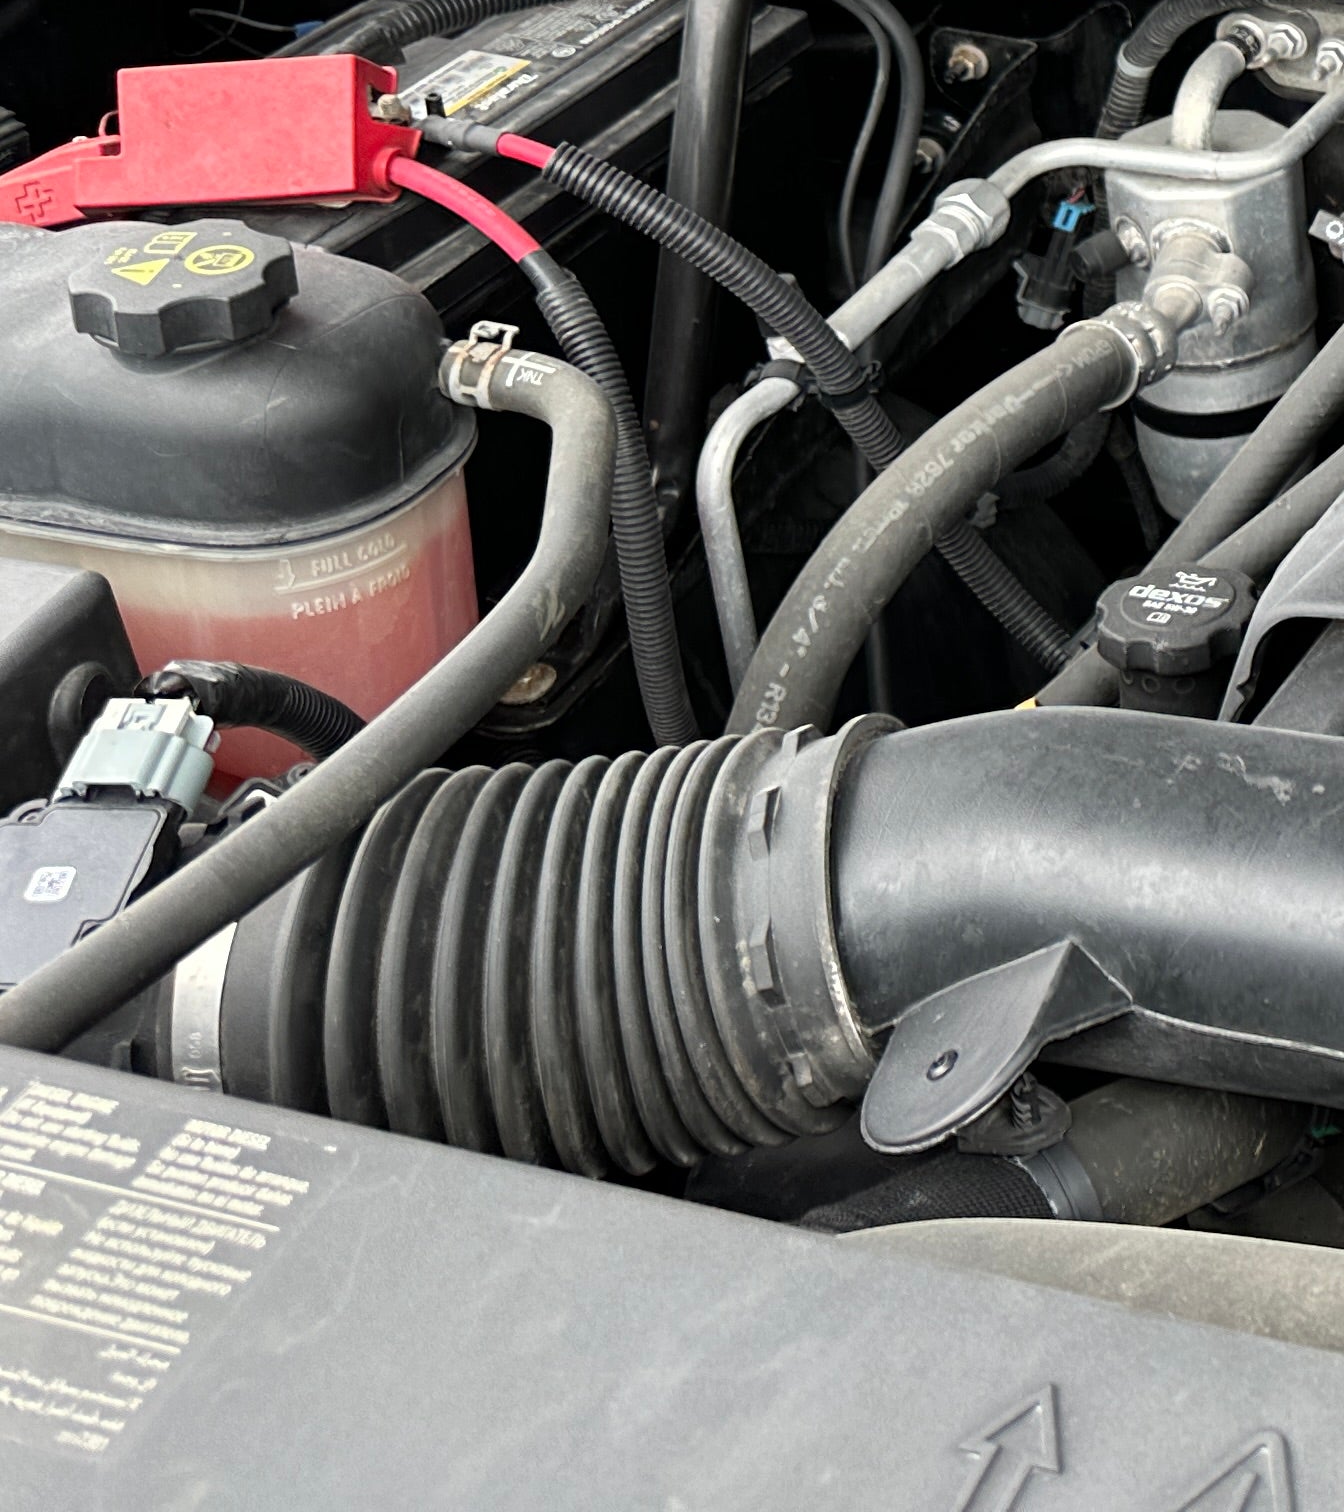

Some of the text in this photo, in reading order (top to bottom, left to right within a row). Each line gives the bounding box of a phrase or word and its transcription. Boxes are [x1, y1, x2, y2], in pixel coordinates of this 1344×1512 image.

[311, 551, 352, 577] FULL
[291, 591, 346, 620] PLEIN
[1128, 584, 1230, 608] dexos
